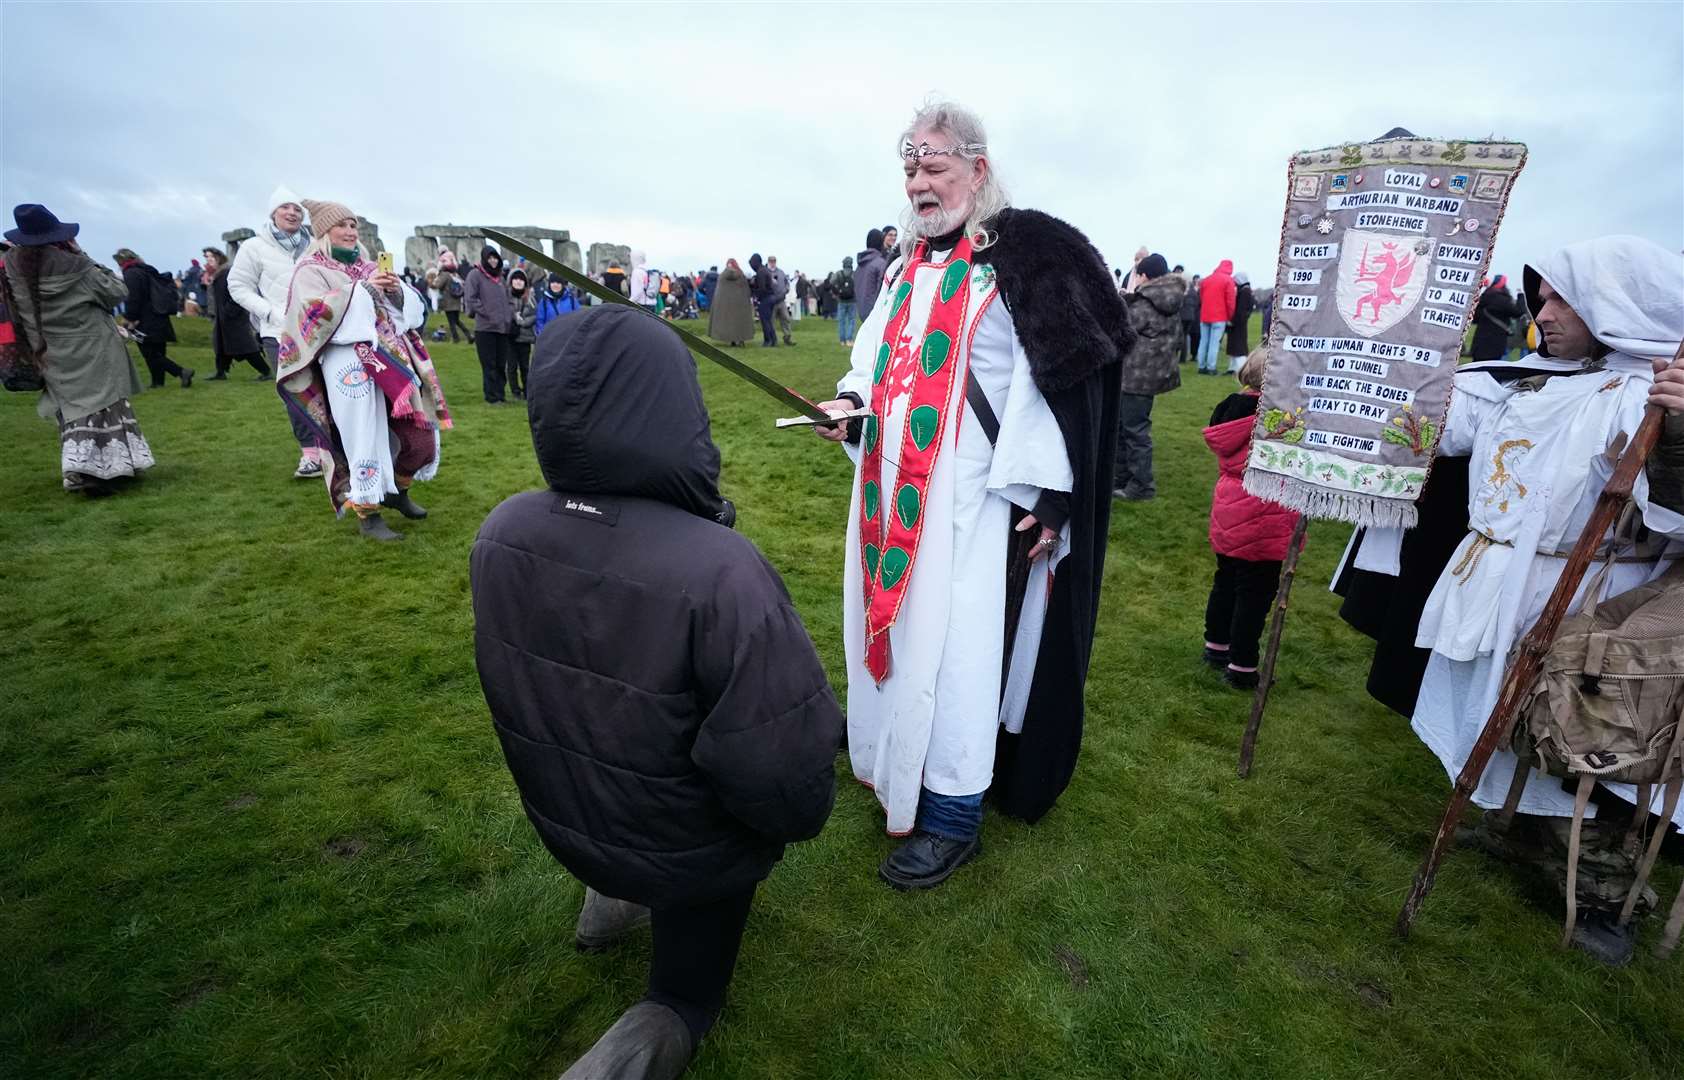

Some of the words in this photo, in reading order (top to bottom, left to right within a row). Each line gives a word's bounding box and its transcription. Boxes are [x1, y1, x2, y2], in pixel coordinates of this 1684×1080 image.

[1386, 173, 1421, 187] LOYAL
[1340, 193, 1399, 207] ARTHURIAN
[1406, 195, 1459, 213] WARBAND
[1359, 215, 1424, 230] STONEHENGE
[1294, 246, 1329, 257] PICKET
[1438, 246, 1482, 261] BYWAYS
[1292, 271, 1313, 281] 1990
[1440, 268, 1470, 282] OPEN
[1287, 296, 1311, 307] 2013
[1429, 288, 1442, 300] TO
[1449, 292, 1465, 305] ALL
[1423, 309, 1461, 326] TRAFFIC
[1291, 338, 1315, 350] COUR
[1331, 339, 1364, 351] HUMAN
[1371, 342, 1406, 357] RIGHTS
[1332, 358, 1345, 369] NO
[1350, 359, 1383, 375] TUNNEL
[1327, 378, 1351, 390] BACK
[1356, 382, 1372, 394] THE
[1376, 386, 1408, 402] BONES
[1343, 401, 1357, 414] TO
[1359, 404, 1385, 419] PRAY
[1308, 432, 1327, 444] STILL
[1332, 435, 1374, 451] FIGHTING
